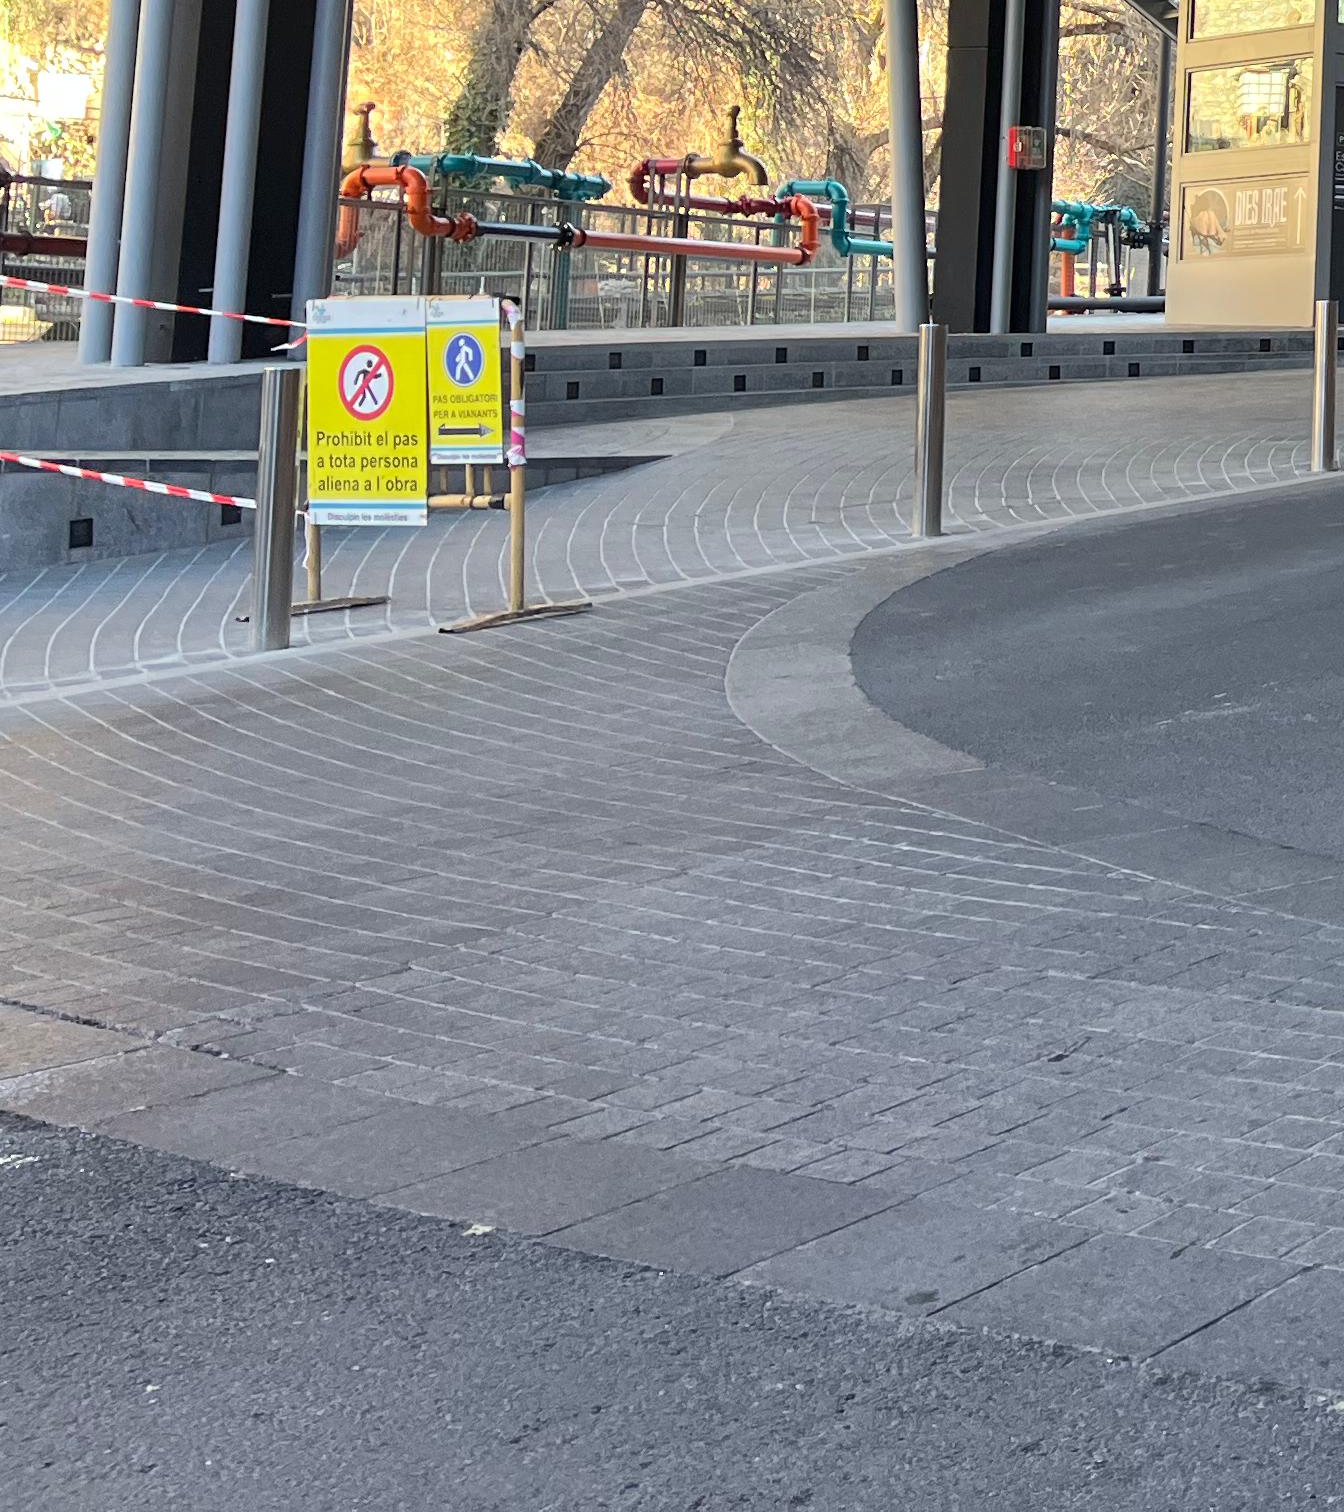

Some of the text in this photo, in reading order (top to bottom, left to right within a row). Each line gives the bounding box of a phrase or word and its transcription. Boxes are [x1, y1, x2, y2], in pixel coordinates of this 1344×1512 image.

[1235, 189, 1259, 226] DIES
[432, 393, 498, 404] PAS OBLIGATORI
[433, 408, 498, 419] PER A VIANANTS
[316, 431, 418, 450] Prohibit el pas
[317, 456, 325, 468] a
[330, 453, 356, 469] tota
[361, 455, 418, 472] persona
[318, 475, 359, 492] aliena
[364, 479, 372, 492] a
